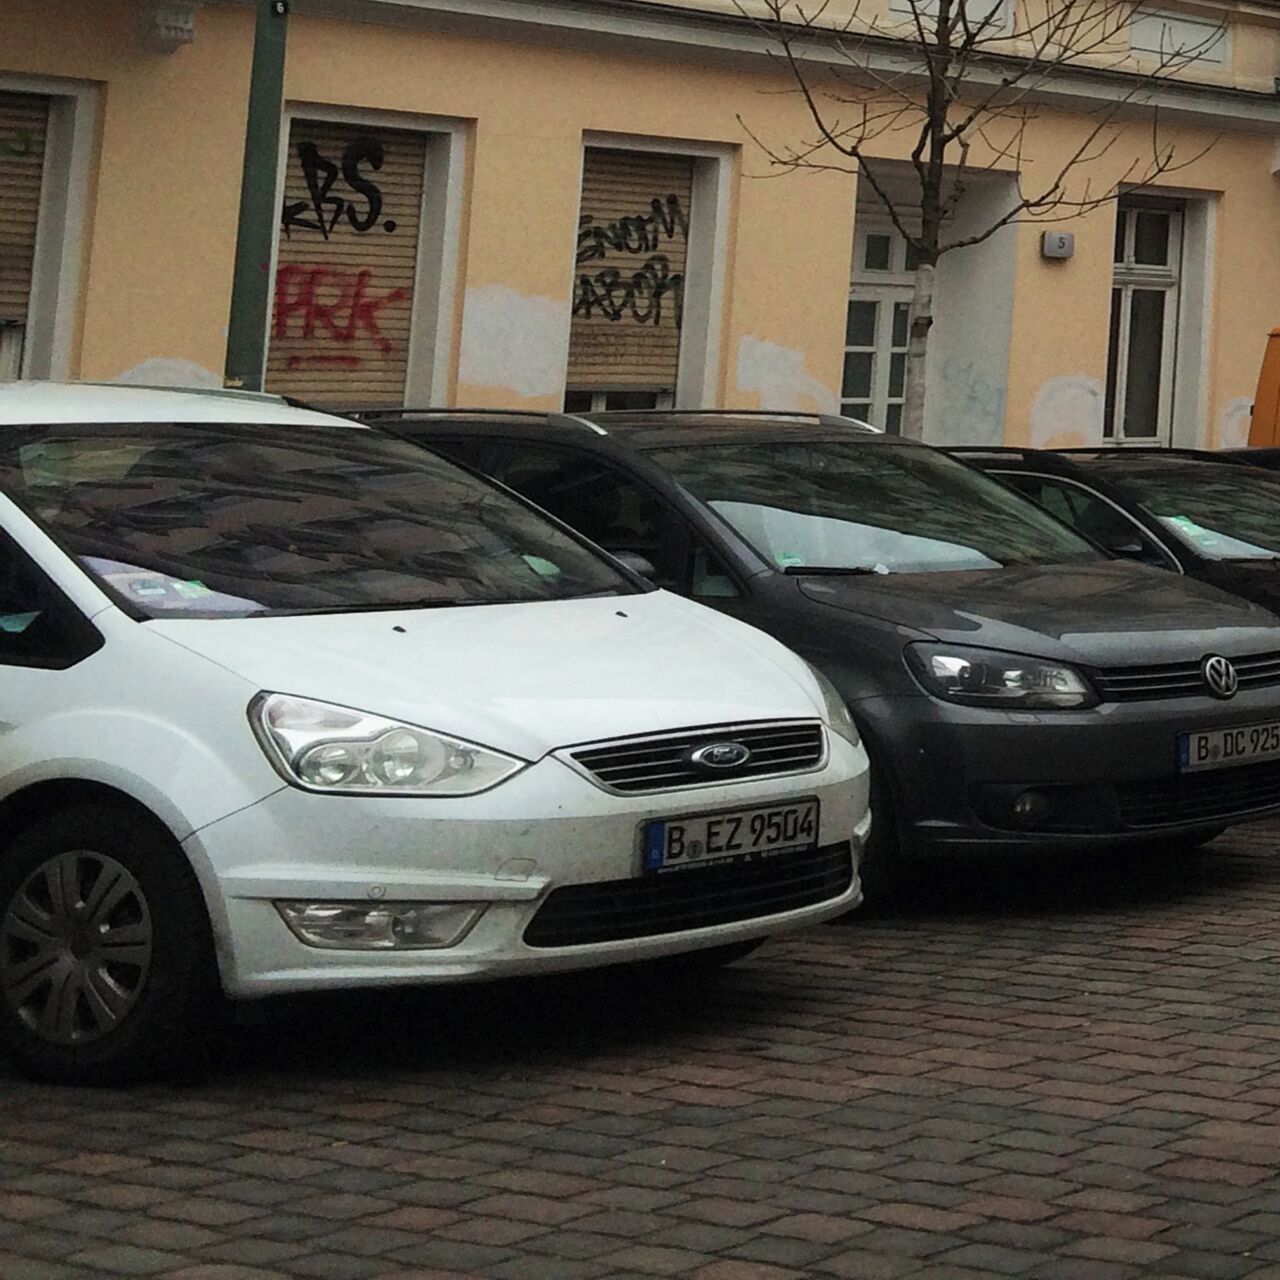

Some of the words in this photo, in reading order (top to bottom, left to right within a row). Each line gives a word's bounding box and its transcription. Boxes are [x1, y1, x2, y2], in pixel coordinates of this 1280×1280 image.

[1058, 236, 1066, 249] 5
[1197, 736, 1209, 761] B
[1223, 730, 1246, 758] DC
[1251, 725, 1280, 754] 925
[666, 826, 686, 860] B
[706, 817, 743, 854] EZ
[751, 806, 814, 847] 9504
